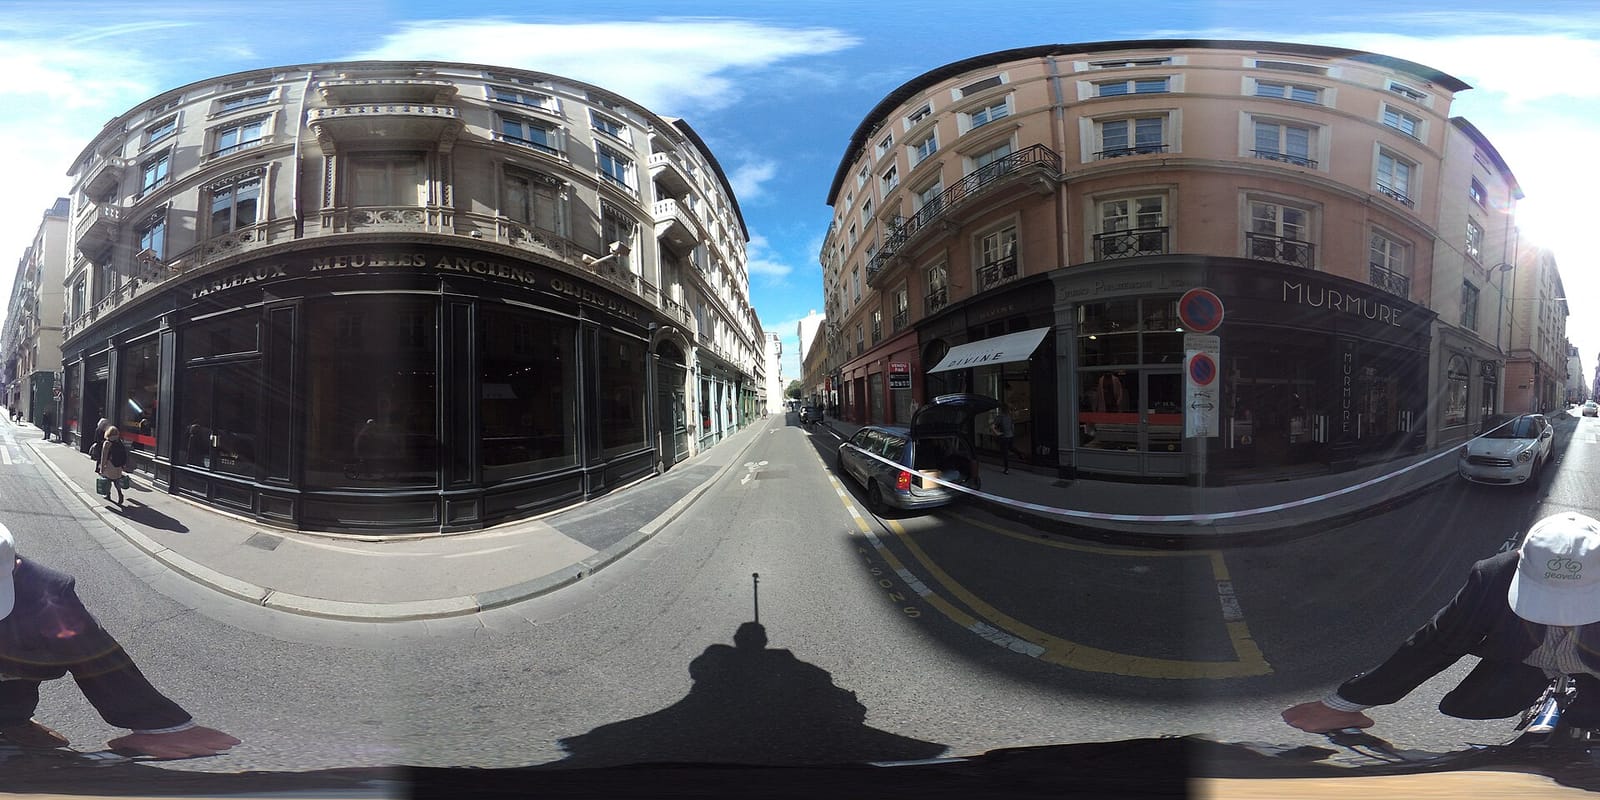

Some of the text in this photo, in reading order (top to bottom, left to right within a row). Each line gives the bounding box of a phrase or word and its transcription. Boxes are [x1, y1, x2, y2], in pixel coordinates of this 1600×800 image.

[191, 263, 288, 300] TABLEAUX
[310, 252, 427, 272] MEUBLES
[435, 256, 536, 285] ANCIENS
[550, 278, 606, 306] OBJETS
[1283, 279, 1403, 328] MURMURE
[947, 351, 1005, 368] DIVINE
[1342, 352, 1352, 433] MURMURE
